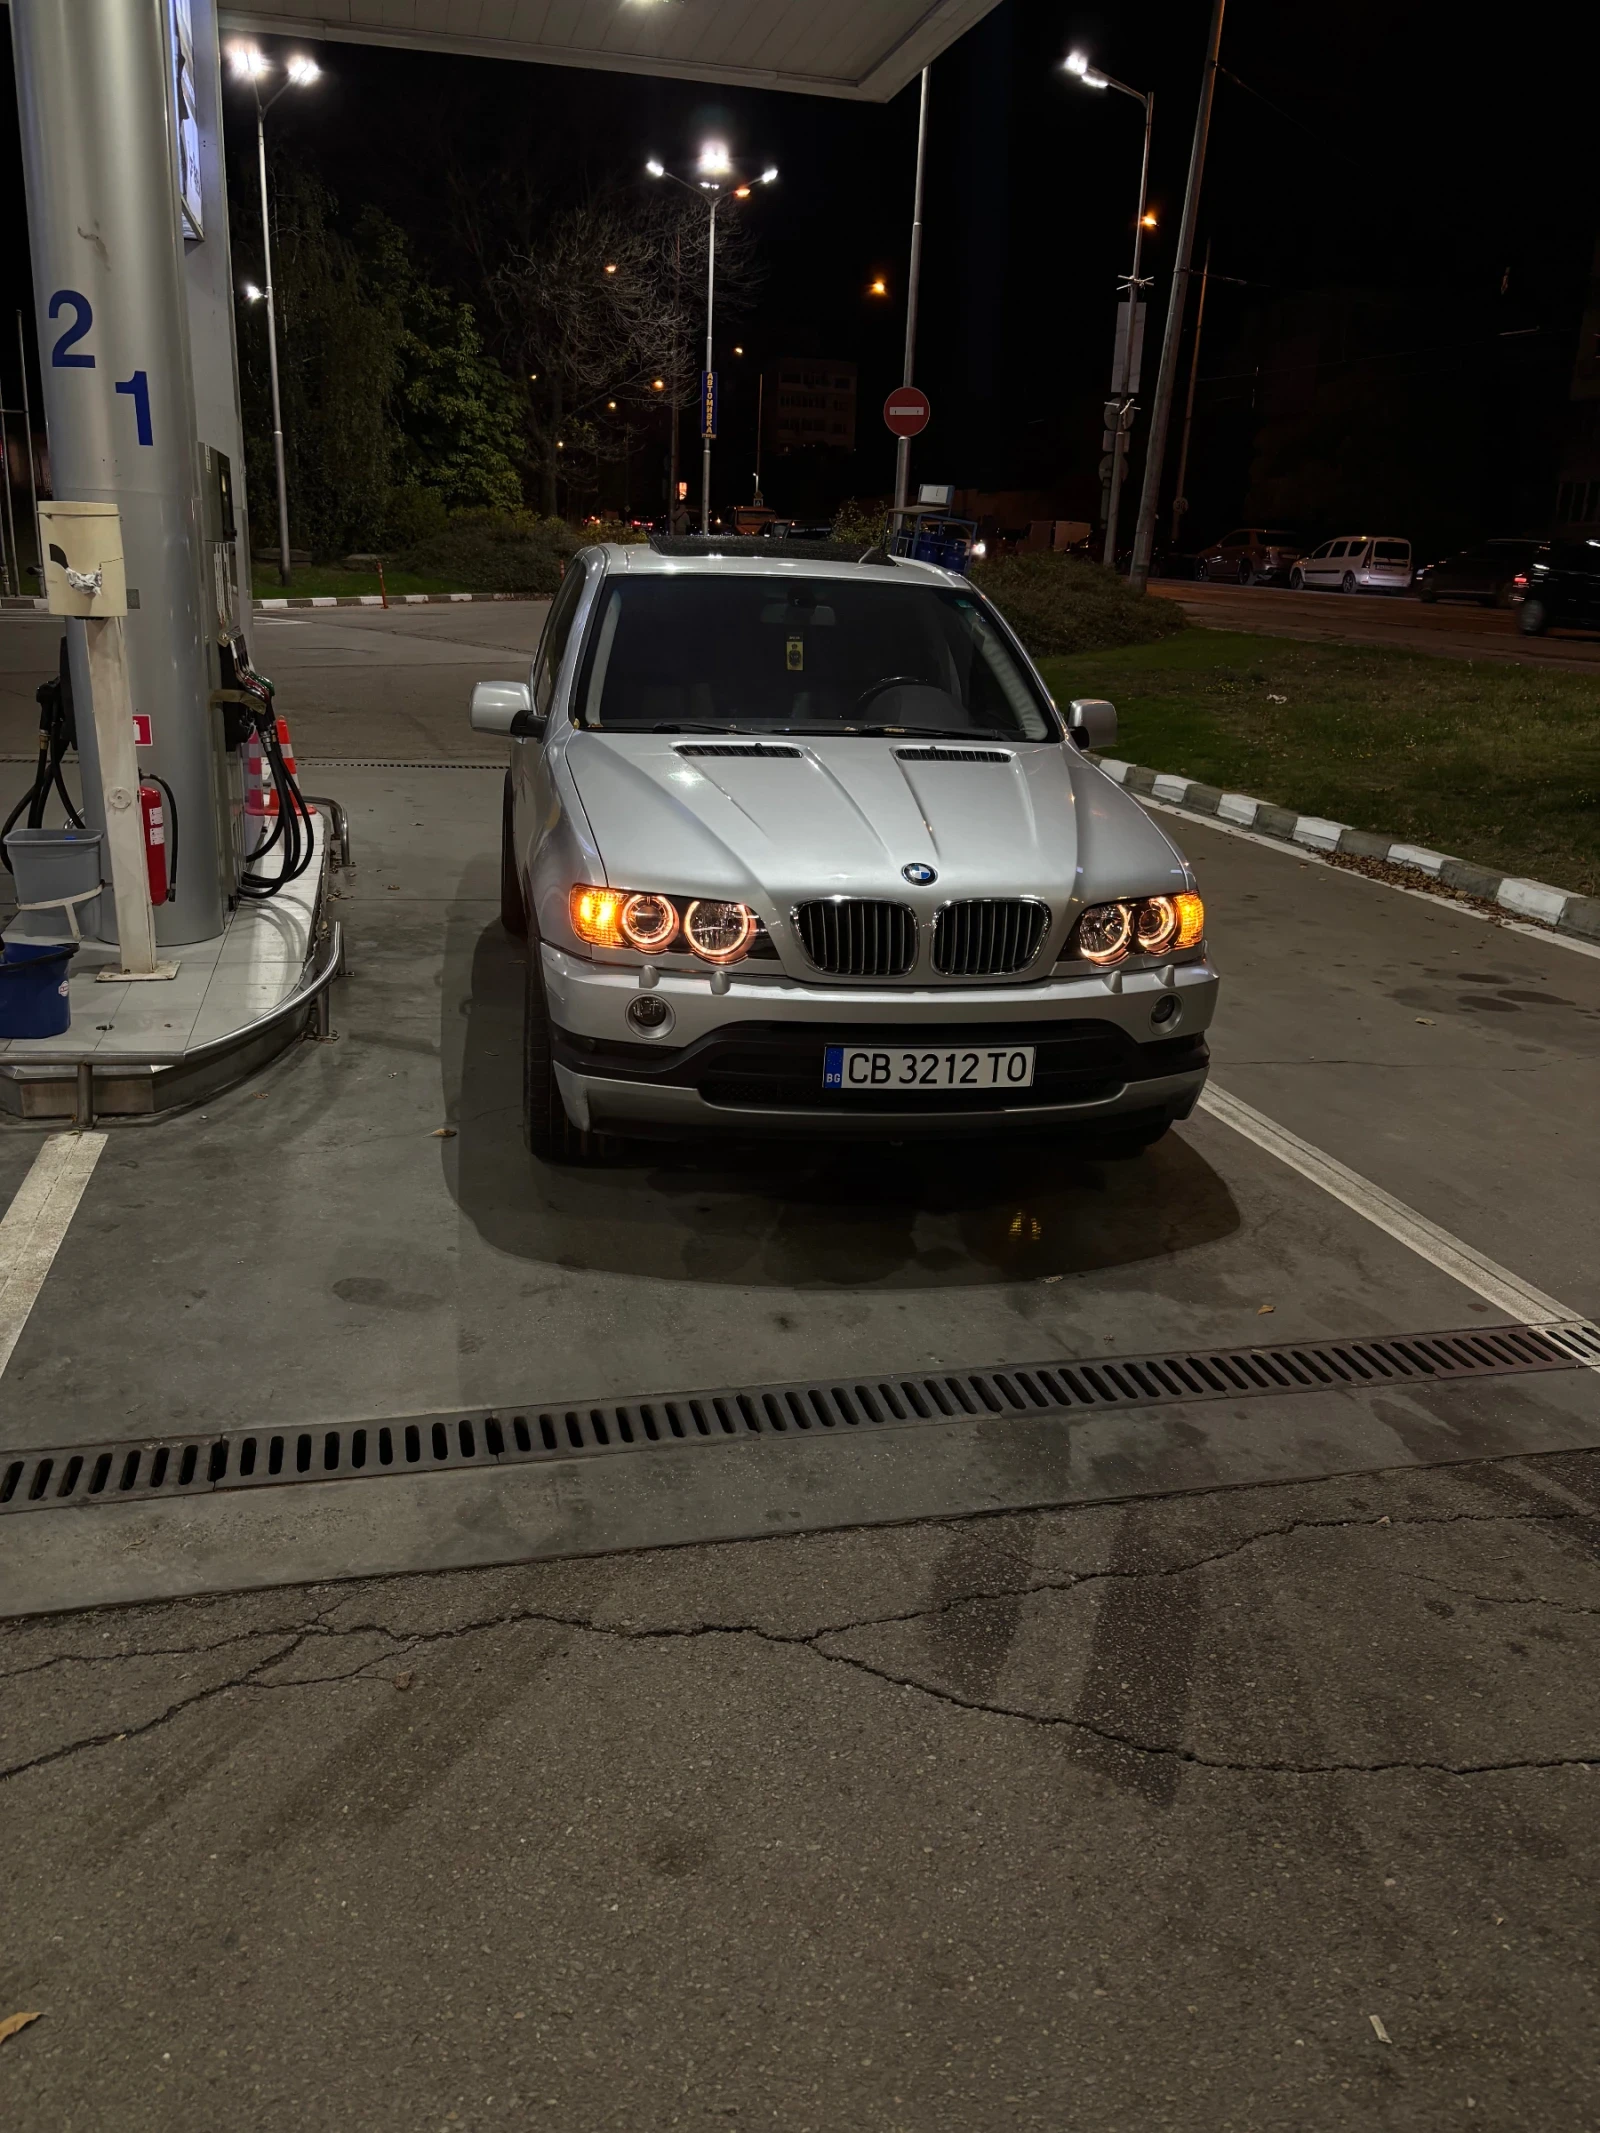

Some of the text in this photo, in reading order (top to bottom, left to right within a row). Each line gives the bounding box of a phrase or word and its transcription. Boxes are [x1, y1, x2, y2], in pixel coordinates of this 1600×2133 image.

[49, 290, 95, 368] 2
[115, 371, 153, 446] 1
[826, 1073, 841, 1083] BG
[848, 1052, 1027, 1084] CB 3212 TO
